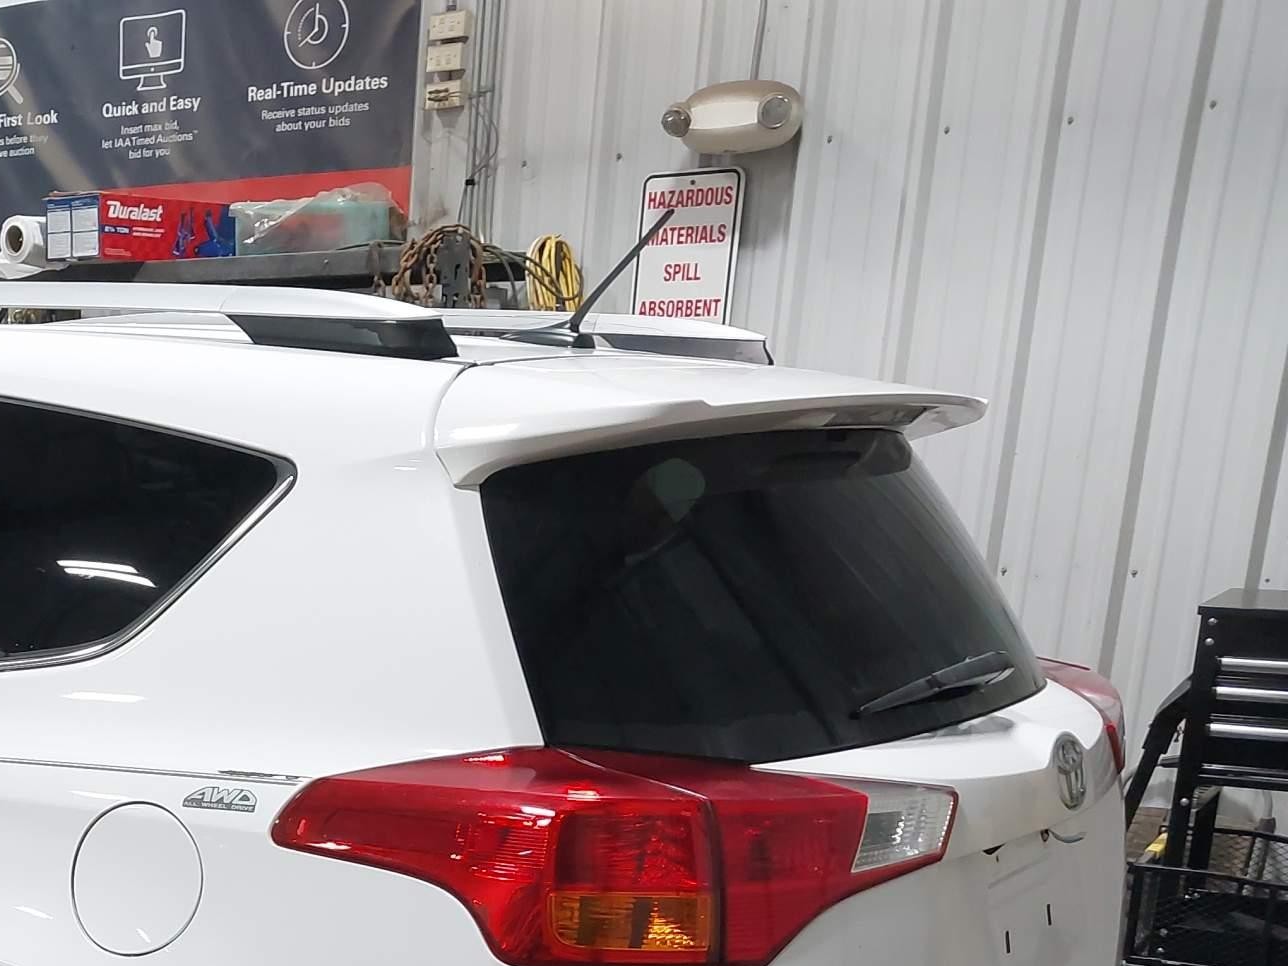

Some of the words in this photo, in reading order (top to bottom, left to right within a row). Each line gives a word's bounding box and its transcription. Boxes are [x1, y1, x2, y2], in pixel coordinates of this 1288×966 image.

[247, 82, 317, 102] Real-Time
[321, 75, 389, 96] Updates
[102, 100, 139, 118] Quick
[141, 97, 167, 114] and
[169, 96, 201, 112] Easy
[261, 108, 296, 120] Receive
[297, 105, 326, 117] status
[328, 102, 369, 115] updates
[26, 110, 59, 125] Look
[275, 121, 302, 132] about
[304, 119, 326, 131] your
[328, 116, 351, 127] bids
[120, 124, 143, 135] Insert
[5, 134, 28, 146] before
[101, 139, 113, 149] let
[114, 137, 131, 148] IAA
[8, 146, 35, 157] auction
[128, 148, 142, 159] bid
[142, 147, 154, 158] for
[154, 148, 171, 159] you
[648, 185, 734, 210] HAZARDOUS
[106, 200, 164, 222] Duralast
[663, 262, 701, 282] SPILL
[638, 298, 722, 318] ABSORBENT
[183, 787, 258, 805] AWD
